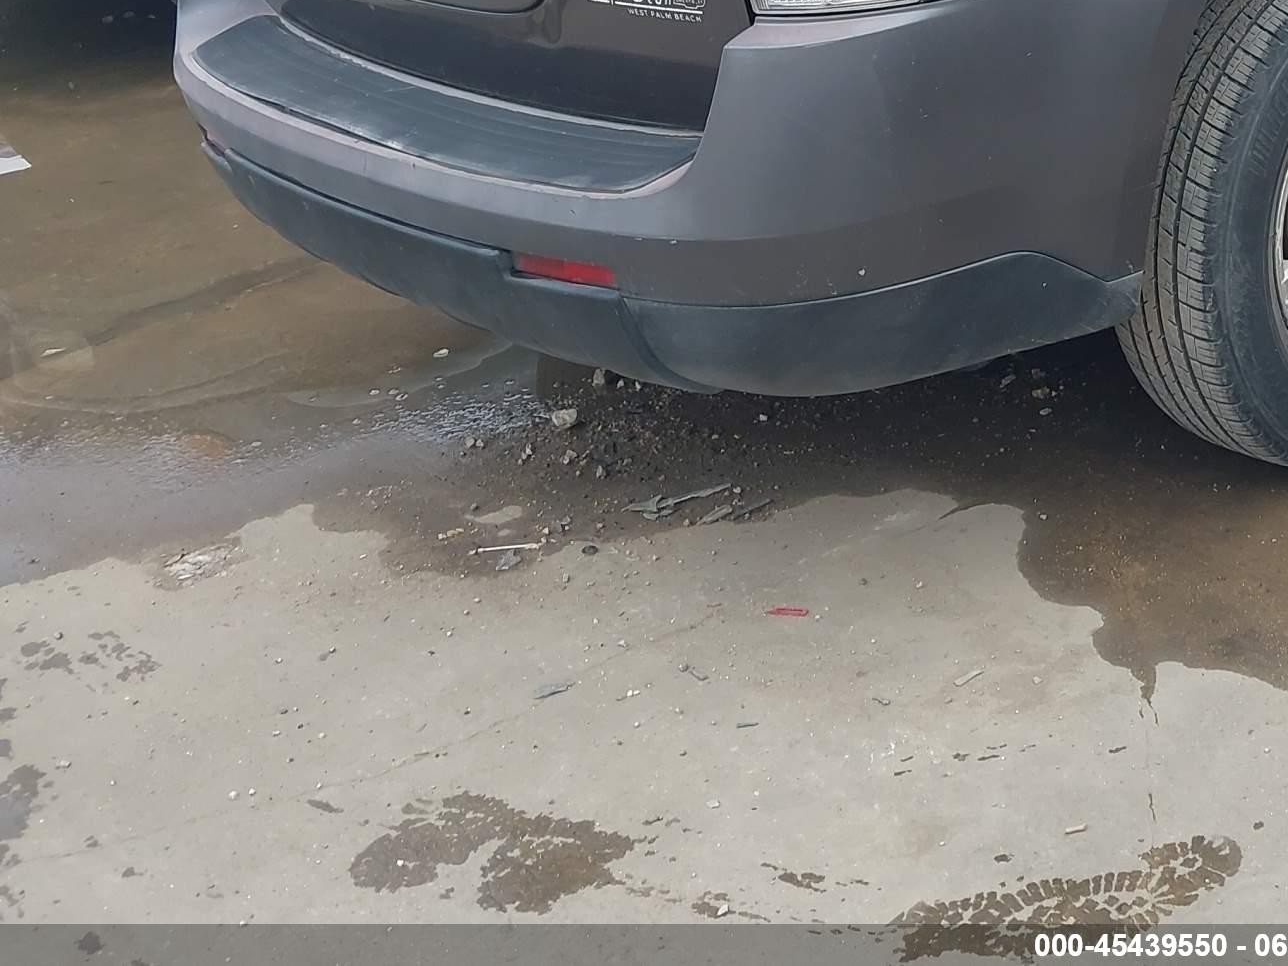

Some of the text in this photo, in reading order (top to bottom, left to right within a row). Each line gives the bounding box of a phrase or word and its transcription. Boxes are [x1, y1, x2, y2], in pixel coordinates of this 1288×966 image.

[627, 8, 703, 23] WEST PALM BEACH
